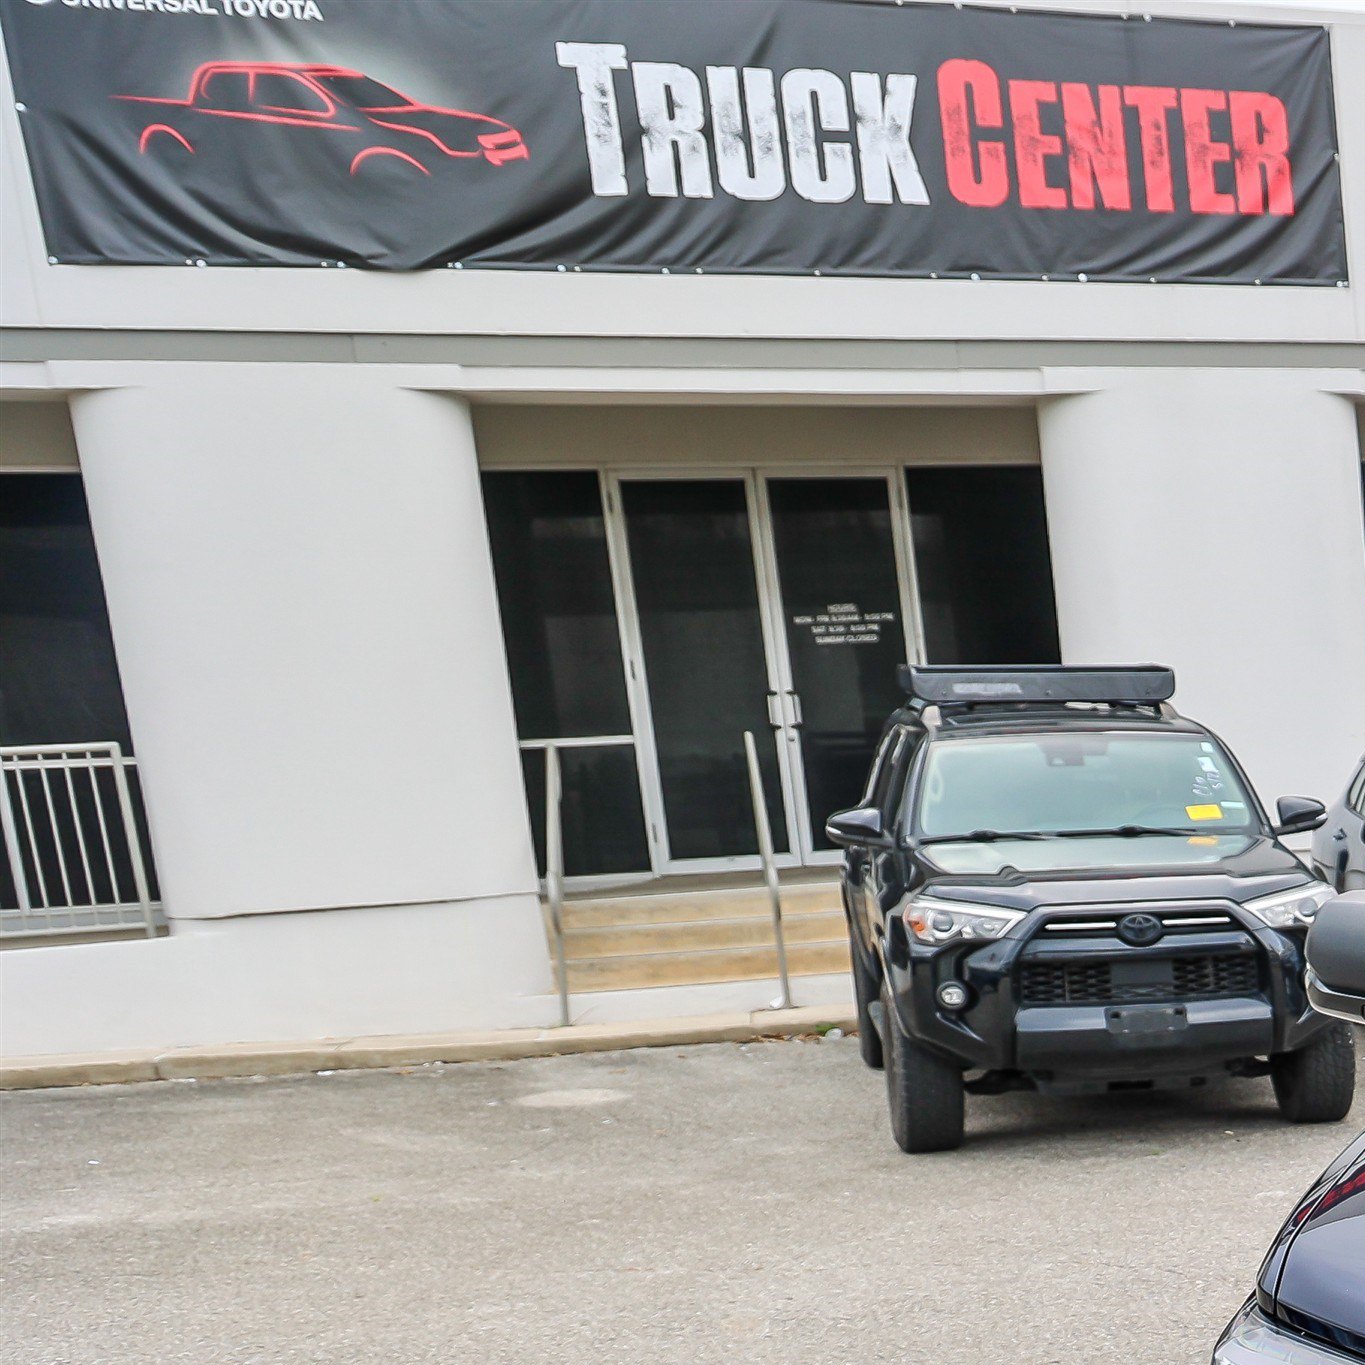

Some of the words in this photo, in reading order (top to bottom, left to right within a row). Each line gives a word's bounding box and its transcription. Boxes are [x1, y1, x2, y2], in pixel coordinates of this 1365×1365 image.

[221, 0, 324, 21] TOYOTA
[555, 41, 931, 205] TRUCK
[936, 58, 1295, 215] CENTER
